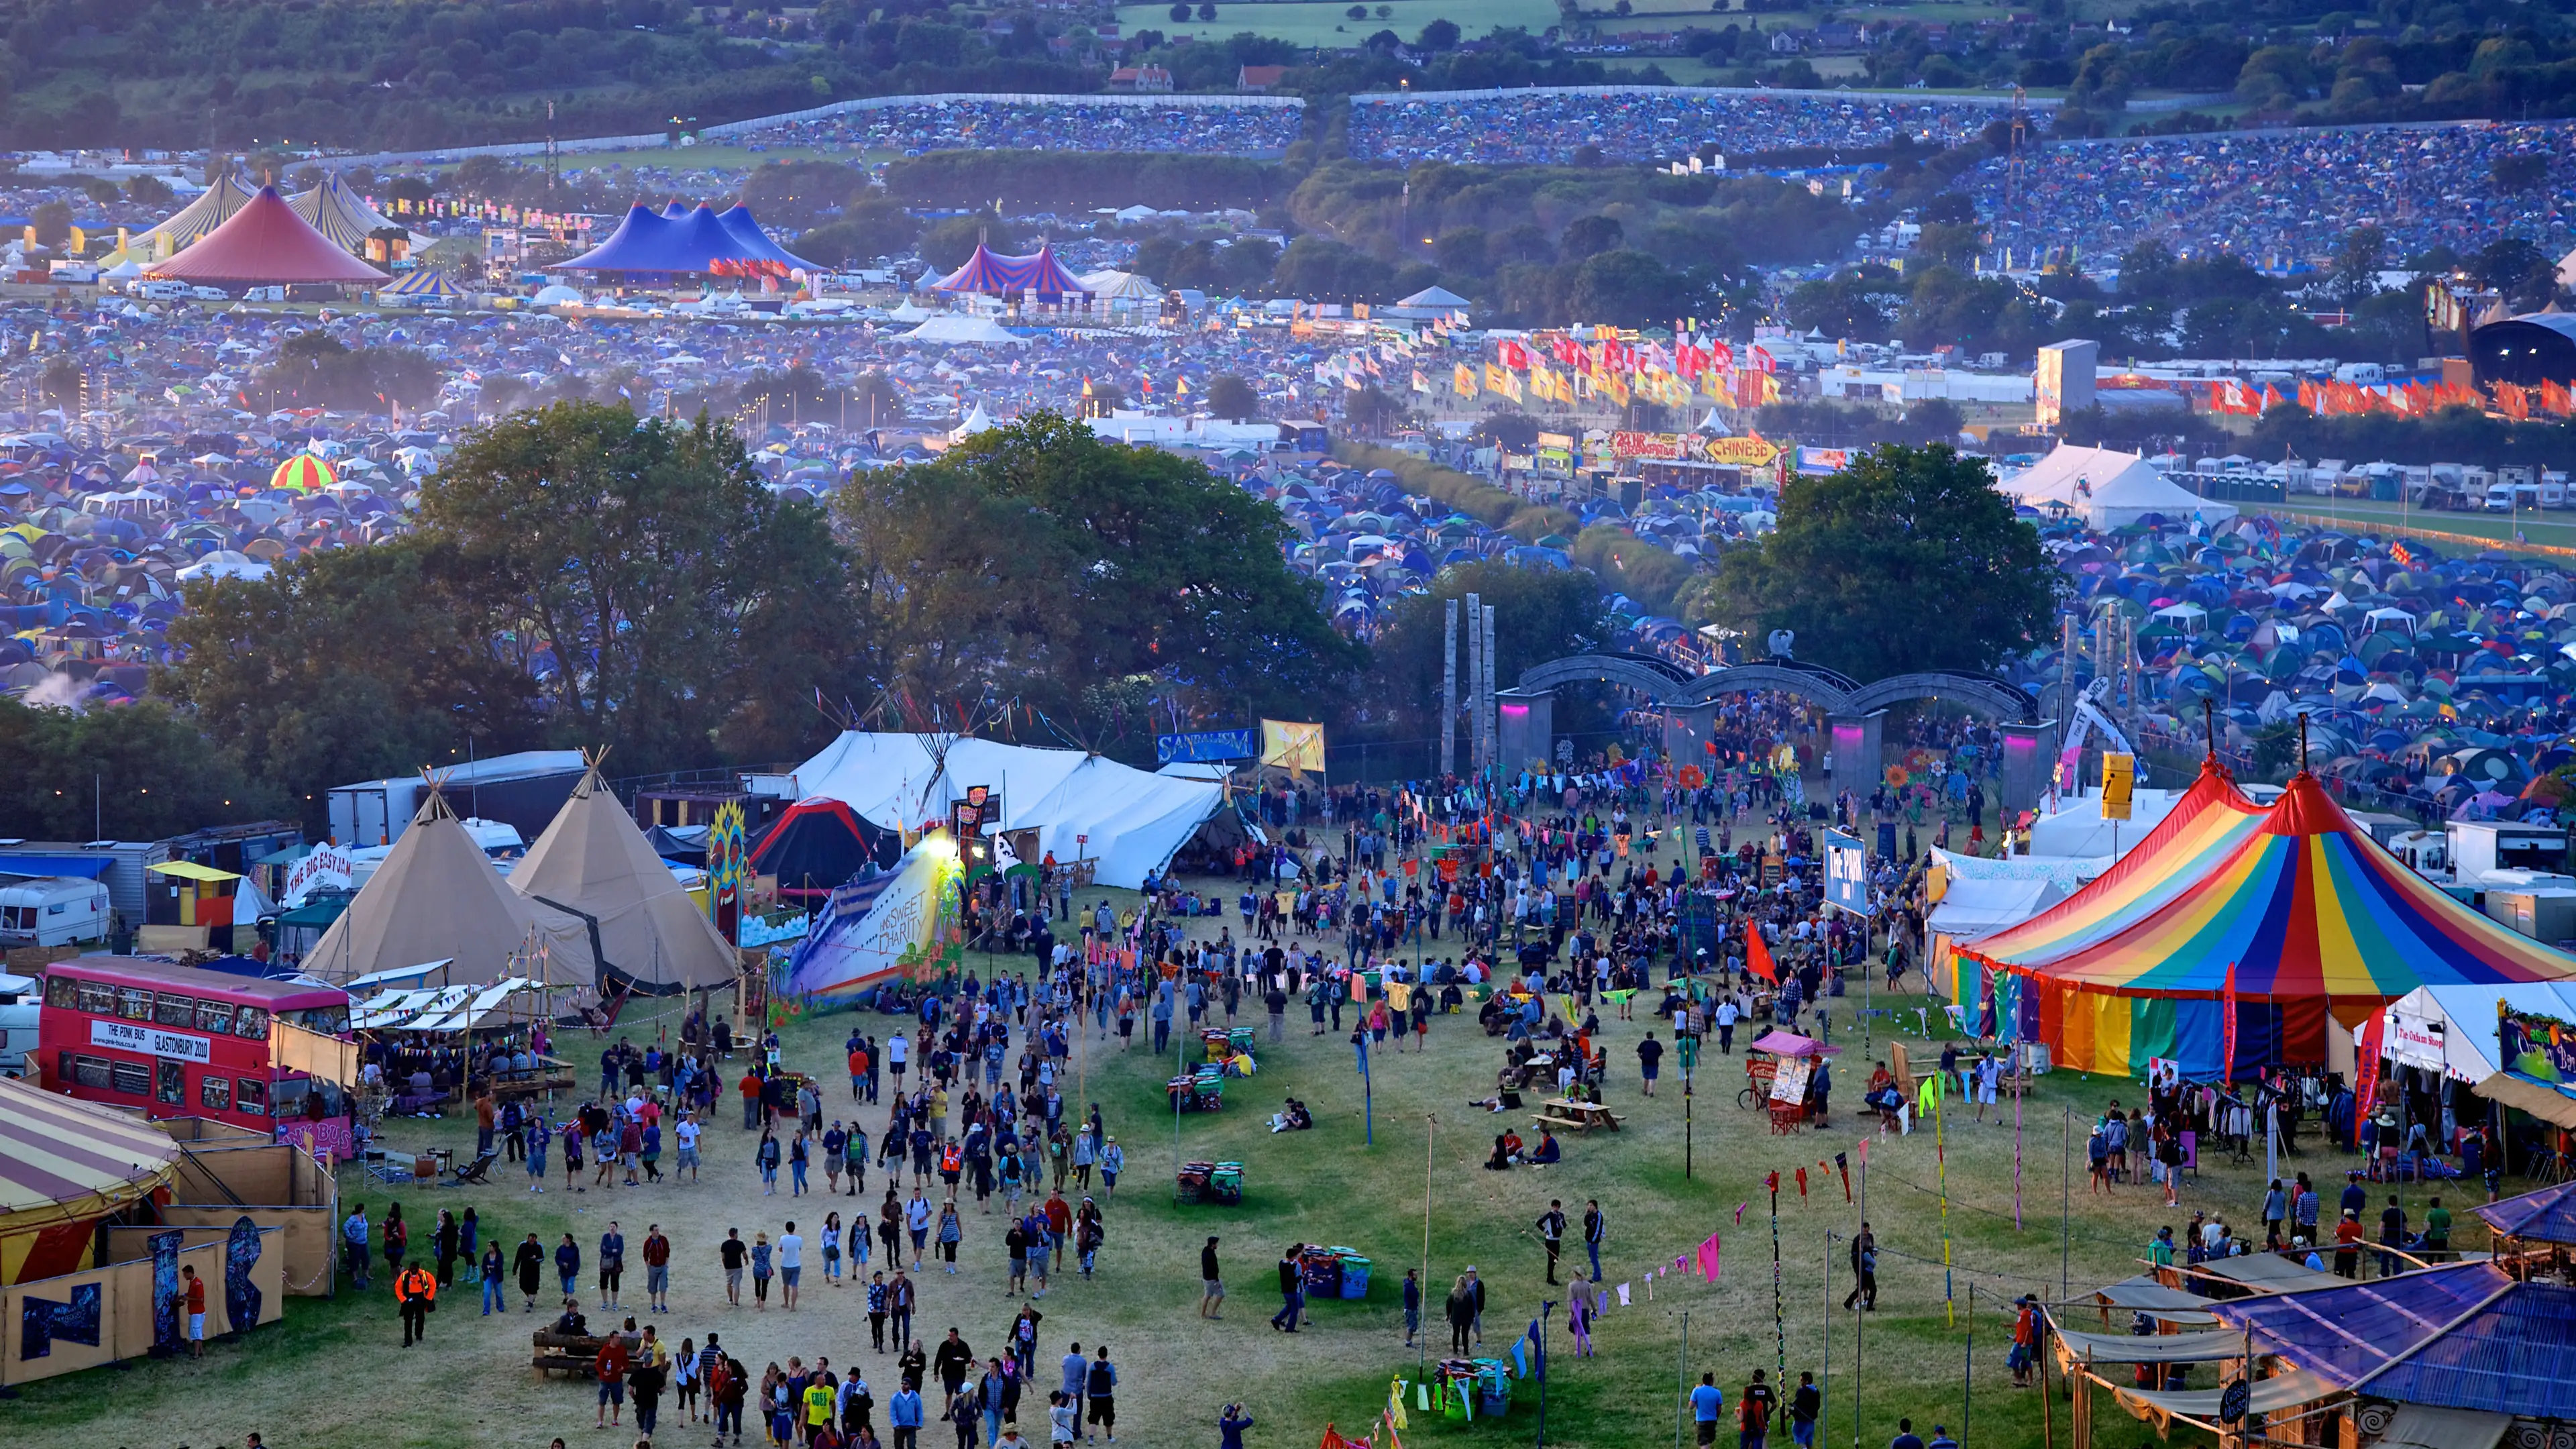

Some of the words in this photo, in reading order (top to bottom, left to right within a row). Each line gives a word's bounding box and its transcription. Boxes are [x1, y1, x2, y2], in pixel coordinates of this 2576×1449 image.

[1713, 440, 1768, 458] CHINESE
[290, 867, 303, 894] THE
[306, 857, 318, 879] BIG
[319, 851, 337, 872] EASY
[337, 857, 350, 878] JAM
[1828, 845, 1843, 879] THE
[1843, 847, 1864, 882] PARK
[890, 890, 926, 928] SWEET
[879, 914, 927, 957] CHARITY
[93, 1036, 137, 1049] www.pink-bus.co.uk
[108, 1024, 119, 1036] THE
[119, 1026, 133, 1039] PINK
[134, 1028, 146, 1040] BUS
[2428, 1035, 2443, 1051] Shop
[154, 1034, 194, 1056] GLASTONBURY
[195, 1041, 207, 1059] 2010
[317, 1123, 352, 1149] BUS
[2225, 1385, 2245, 1405] Glass
[2224, 1398, 2246, 1421] House
